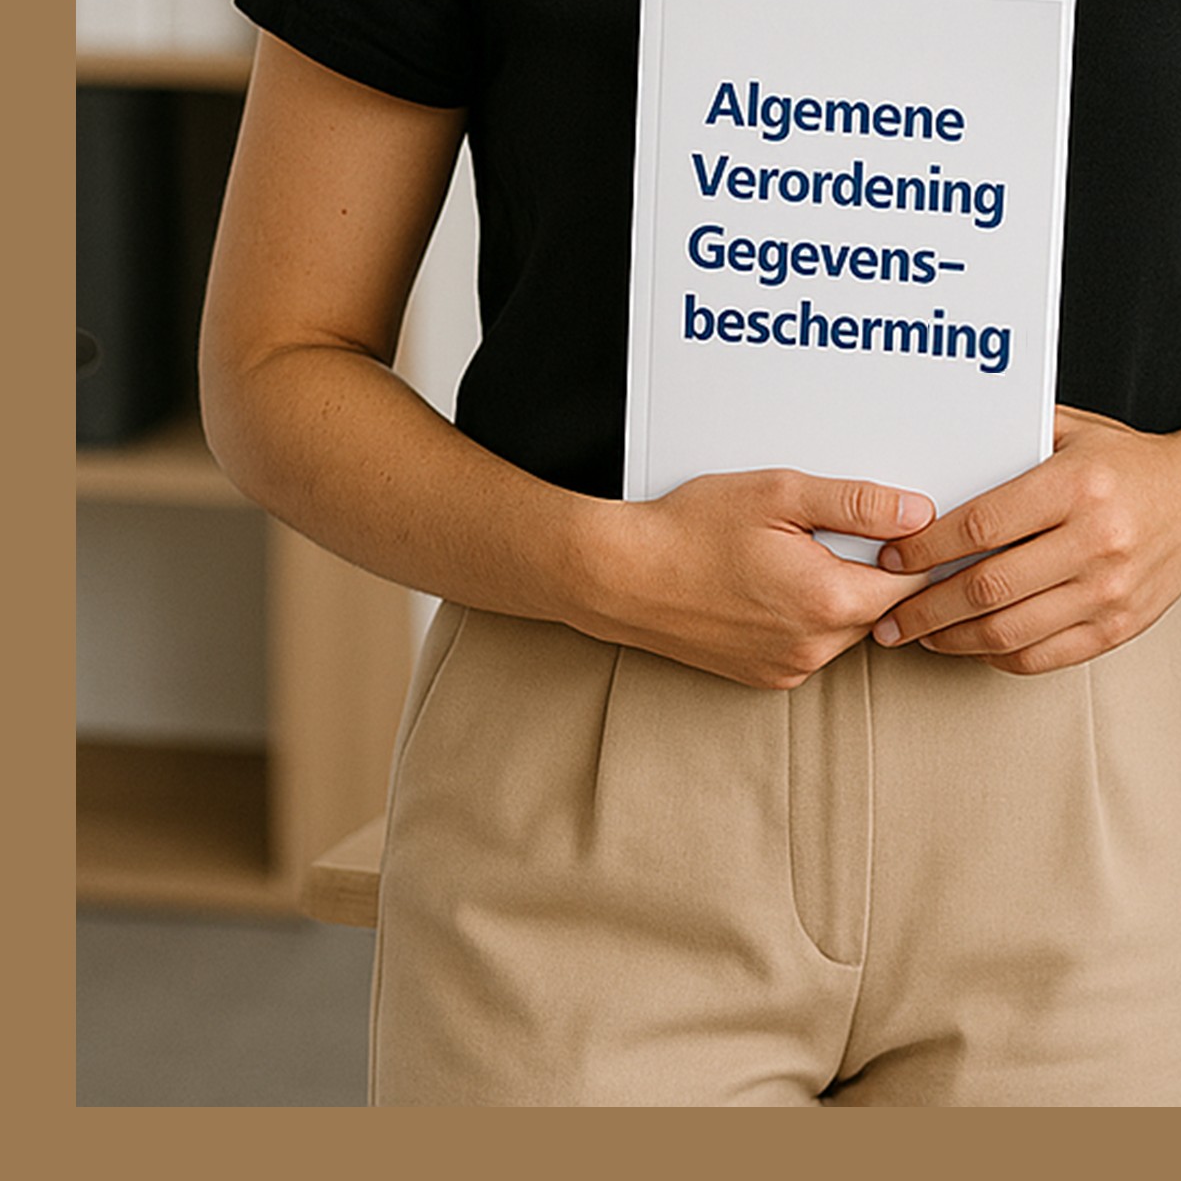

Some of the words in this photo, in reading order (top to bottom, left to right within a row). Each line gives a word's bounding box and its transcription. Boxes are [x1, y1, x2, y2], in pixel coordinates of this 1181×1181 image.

[705, 81, 965, 142] Algemene
[691, 153, 1005, 229] Verordening
[688, 224, 965, 287] Gegevens-
[684, 293, 1011, 374] bescherming
